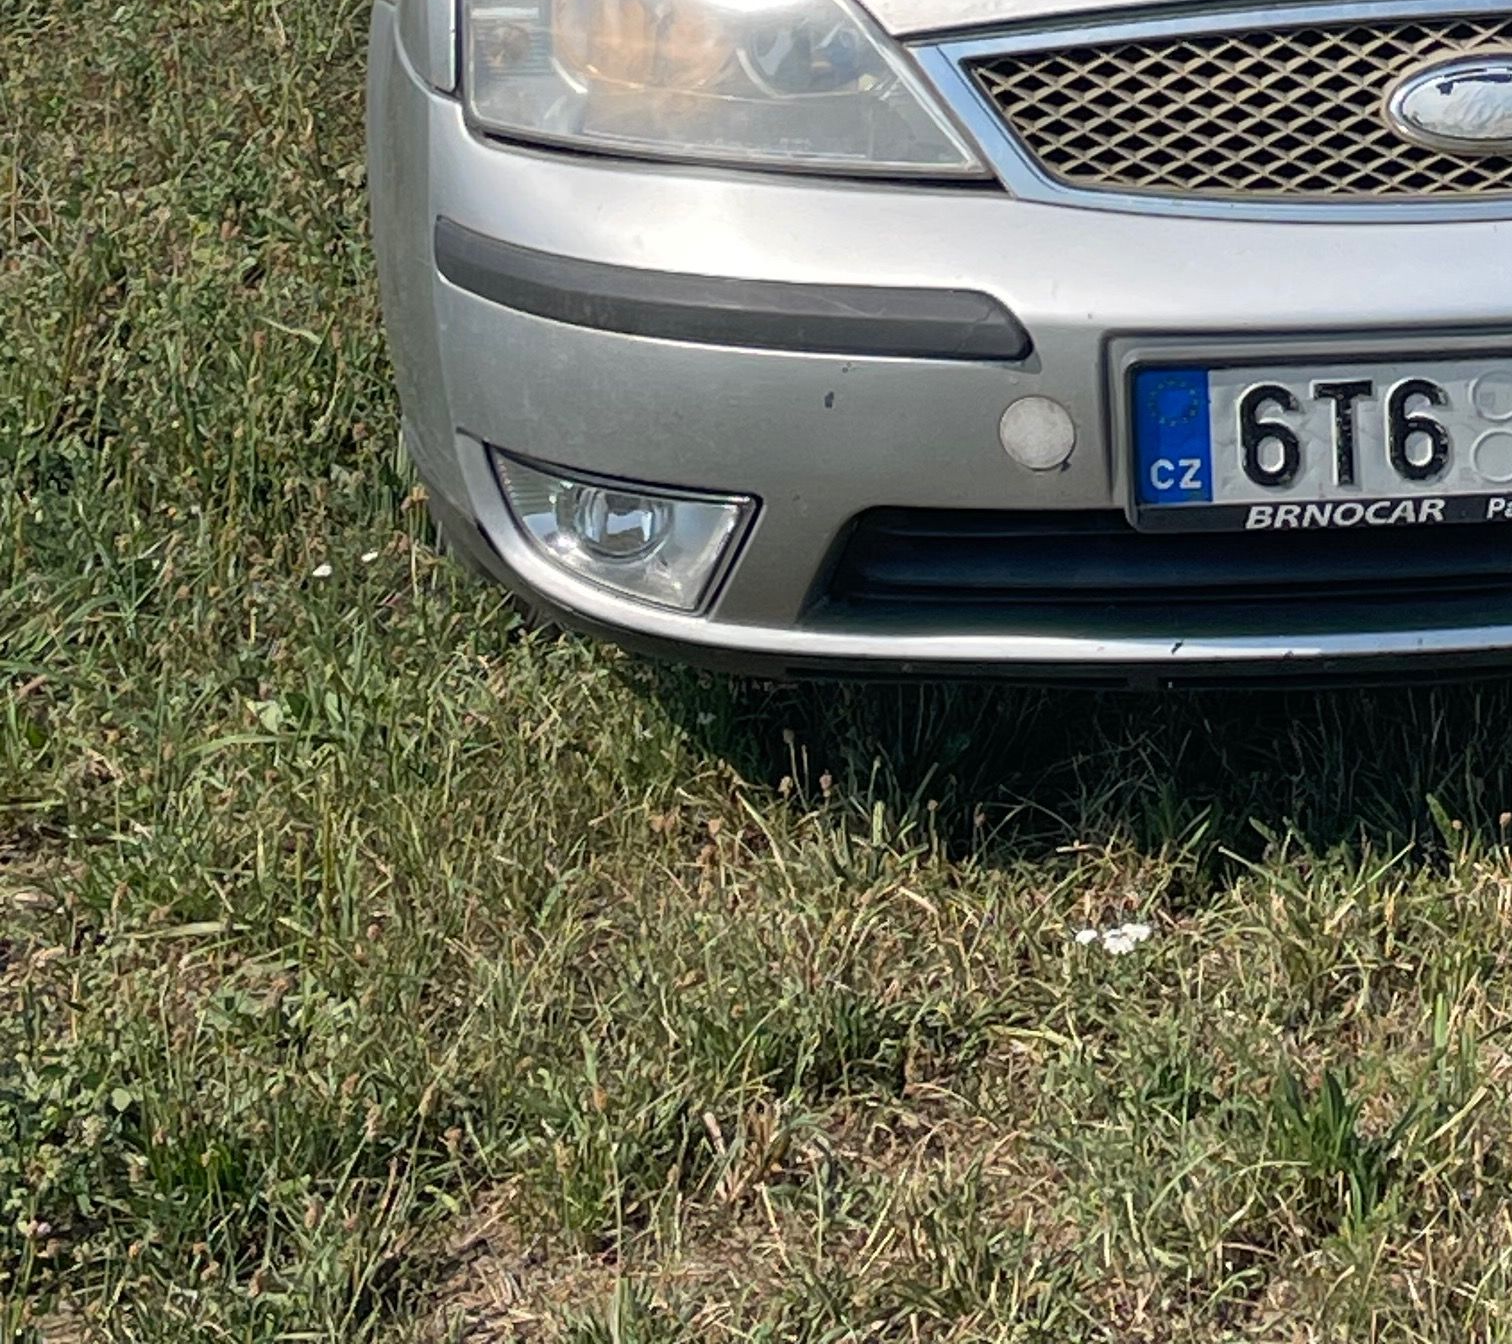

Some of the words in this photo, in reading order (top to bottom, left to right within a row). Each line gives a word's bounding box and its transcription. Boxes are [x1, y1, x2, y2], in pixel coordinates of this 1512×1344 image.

[1240, 377, 1451, 488] 6T6
[1150, 458, 1202, 490] CZ
[1245, 498, 1446, 530] BRNOCAR
